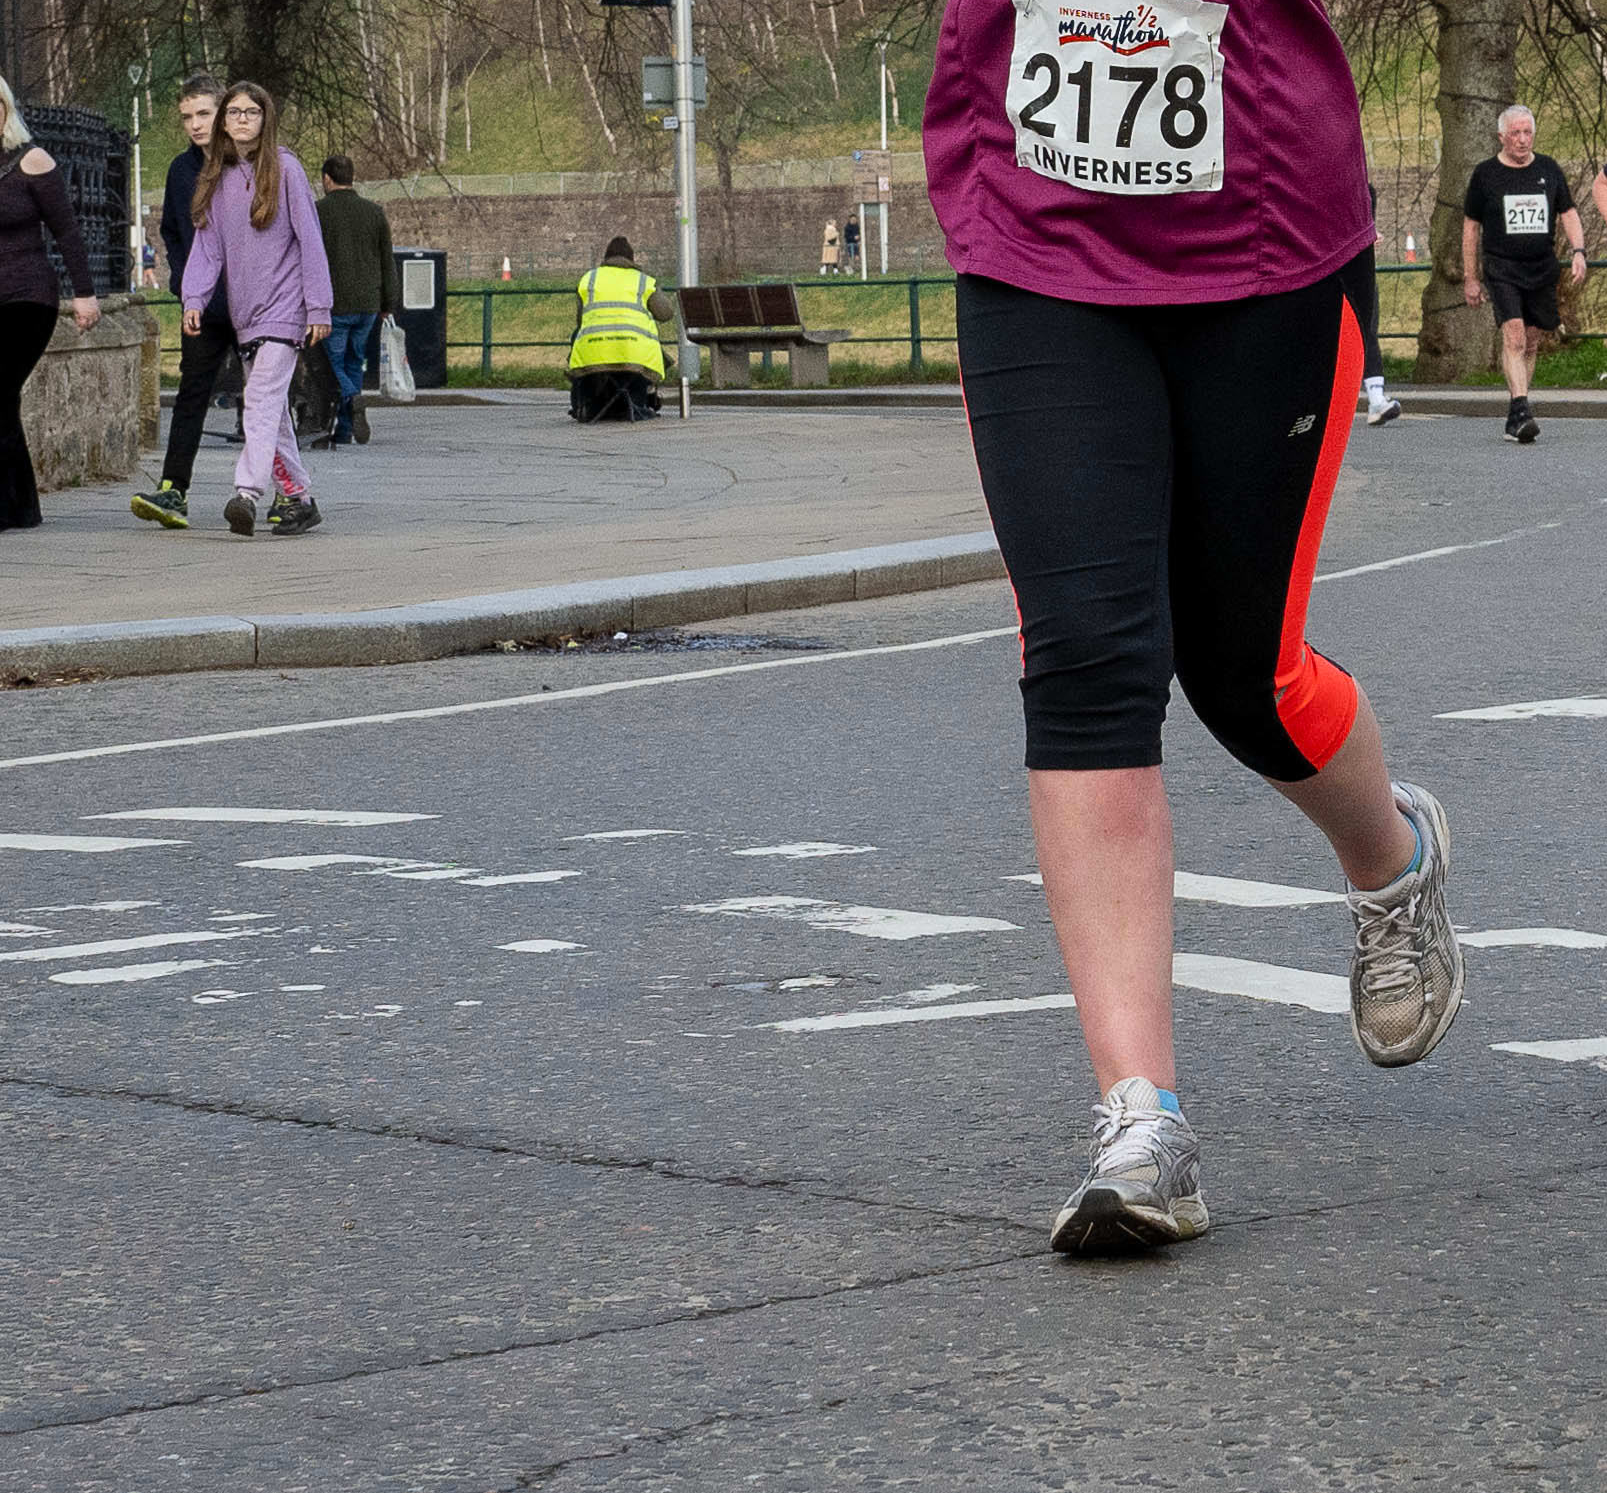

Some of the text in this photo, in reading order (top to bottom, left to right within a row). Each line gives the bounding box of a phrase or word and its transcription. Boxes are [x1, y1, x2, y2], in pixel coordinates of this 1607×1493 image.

[1058, 10, 1170, 53] marathon
[1059, 6, 1111, 21] INVERNESS
[1018, 52, 1208, 150] 2178
[1033, 143, 1194, 186] INVERNESS
[1508, 208, 1546, 225] 2174
